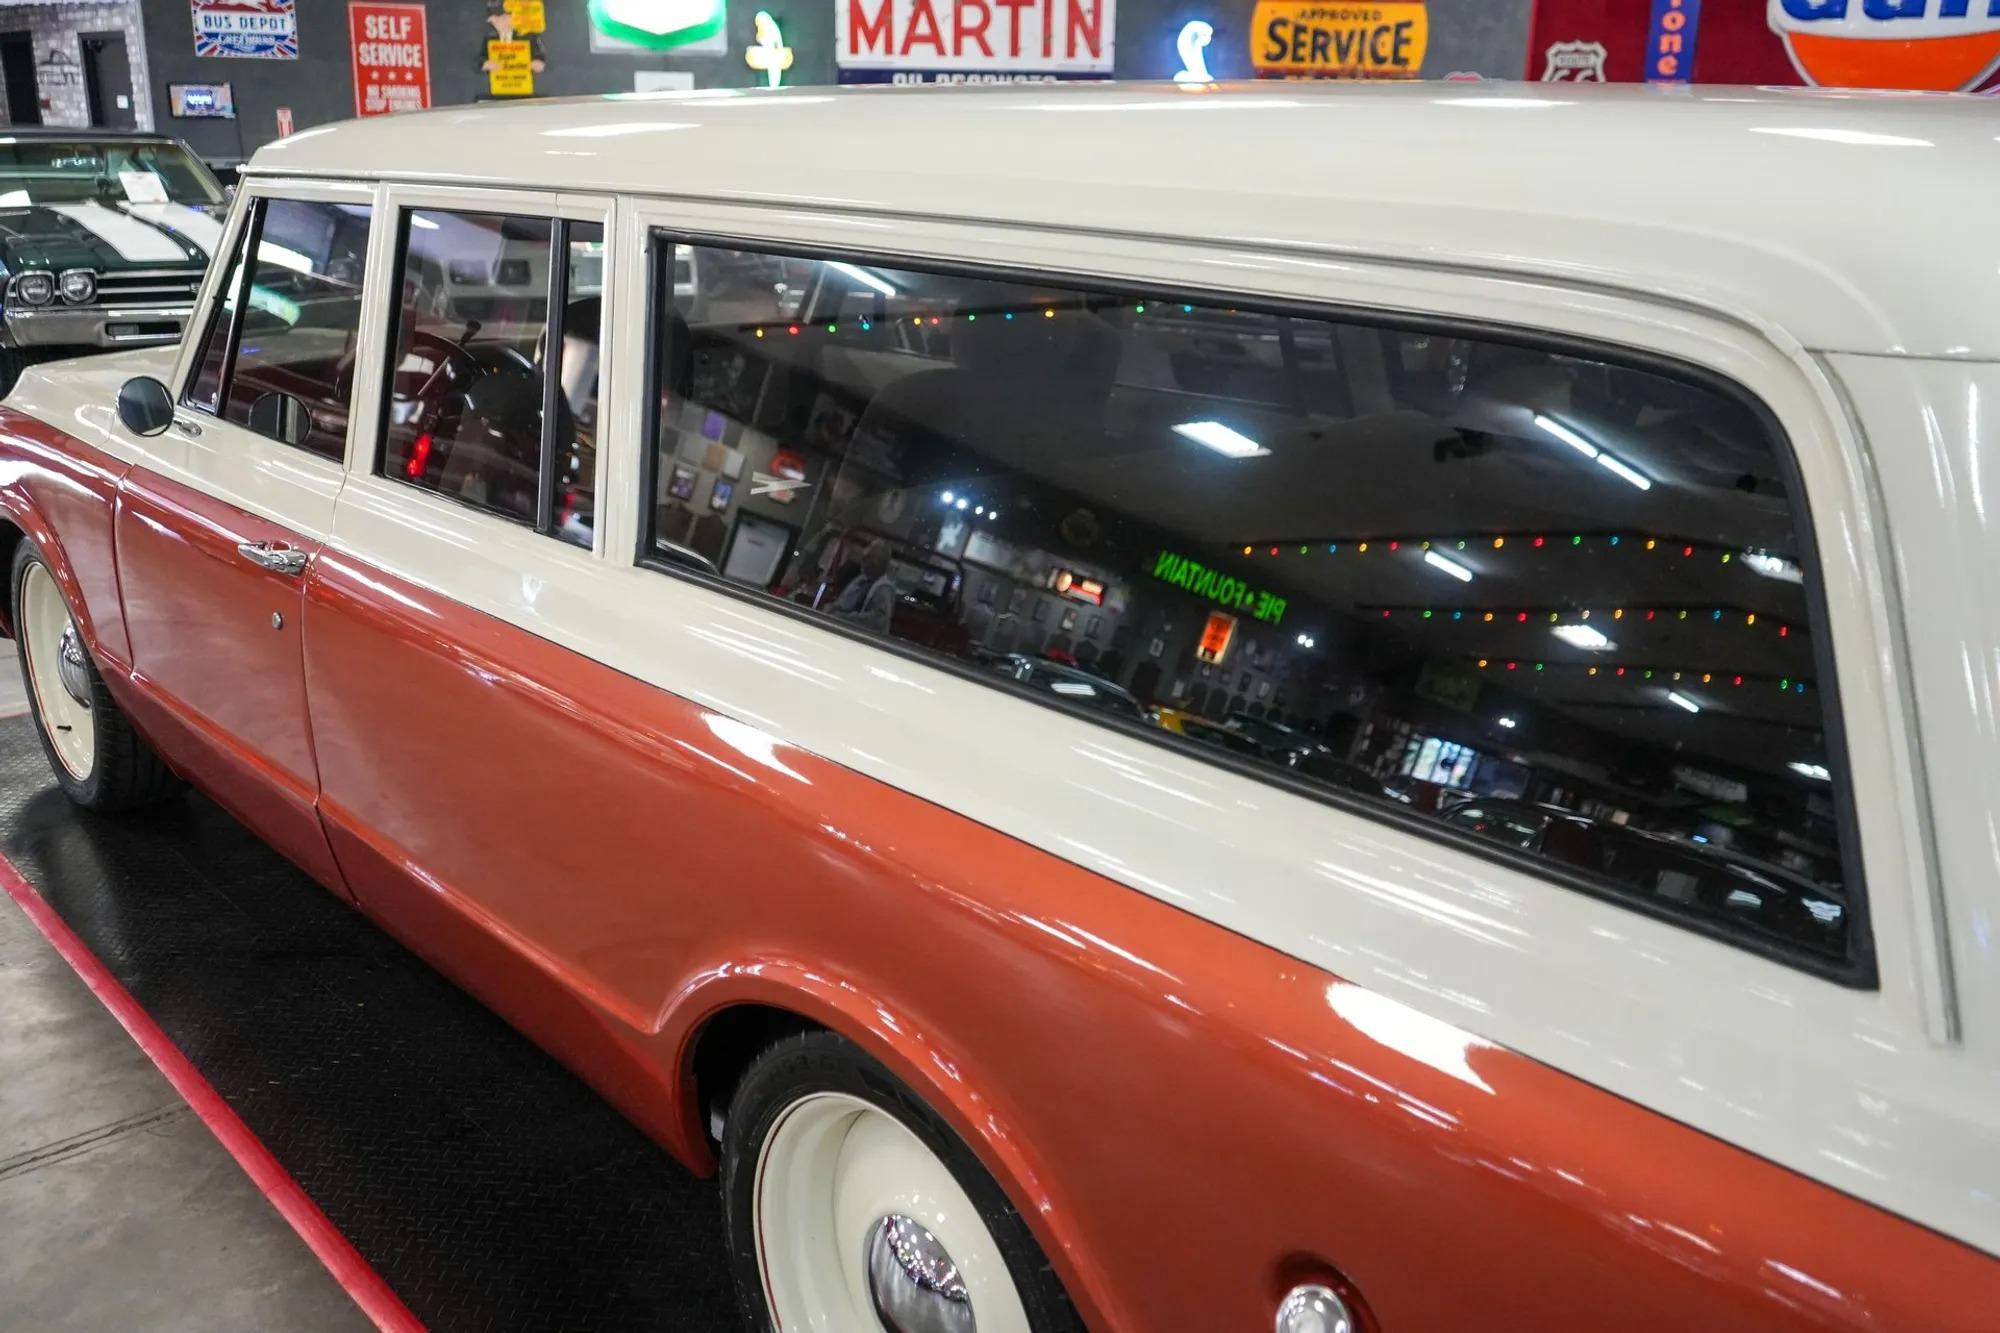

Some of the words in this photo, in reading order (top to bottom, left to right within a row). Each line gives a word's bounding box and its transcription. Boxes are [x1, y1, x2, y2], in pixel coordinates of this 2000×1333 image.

[204, 15, 232, 28] BUS
[240, 16, 285, 31] DEPOT
[365, 15, 411, 40] SELF
[1300, 9, 1382, 21] APPROVED
[850, 0, 1103, 58] MARTIN
[1264, 17, 1413, 66] SERVICE
[1657, 0, 1686, 76] one
[359, 42, 422, 68] SERVICE
